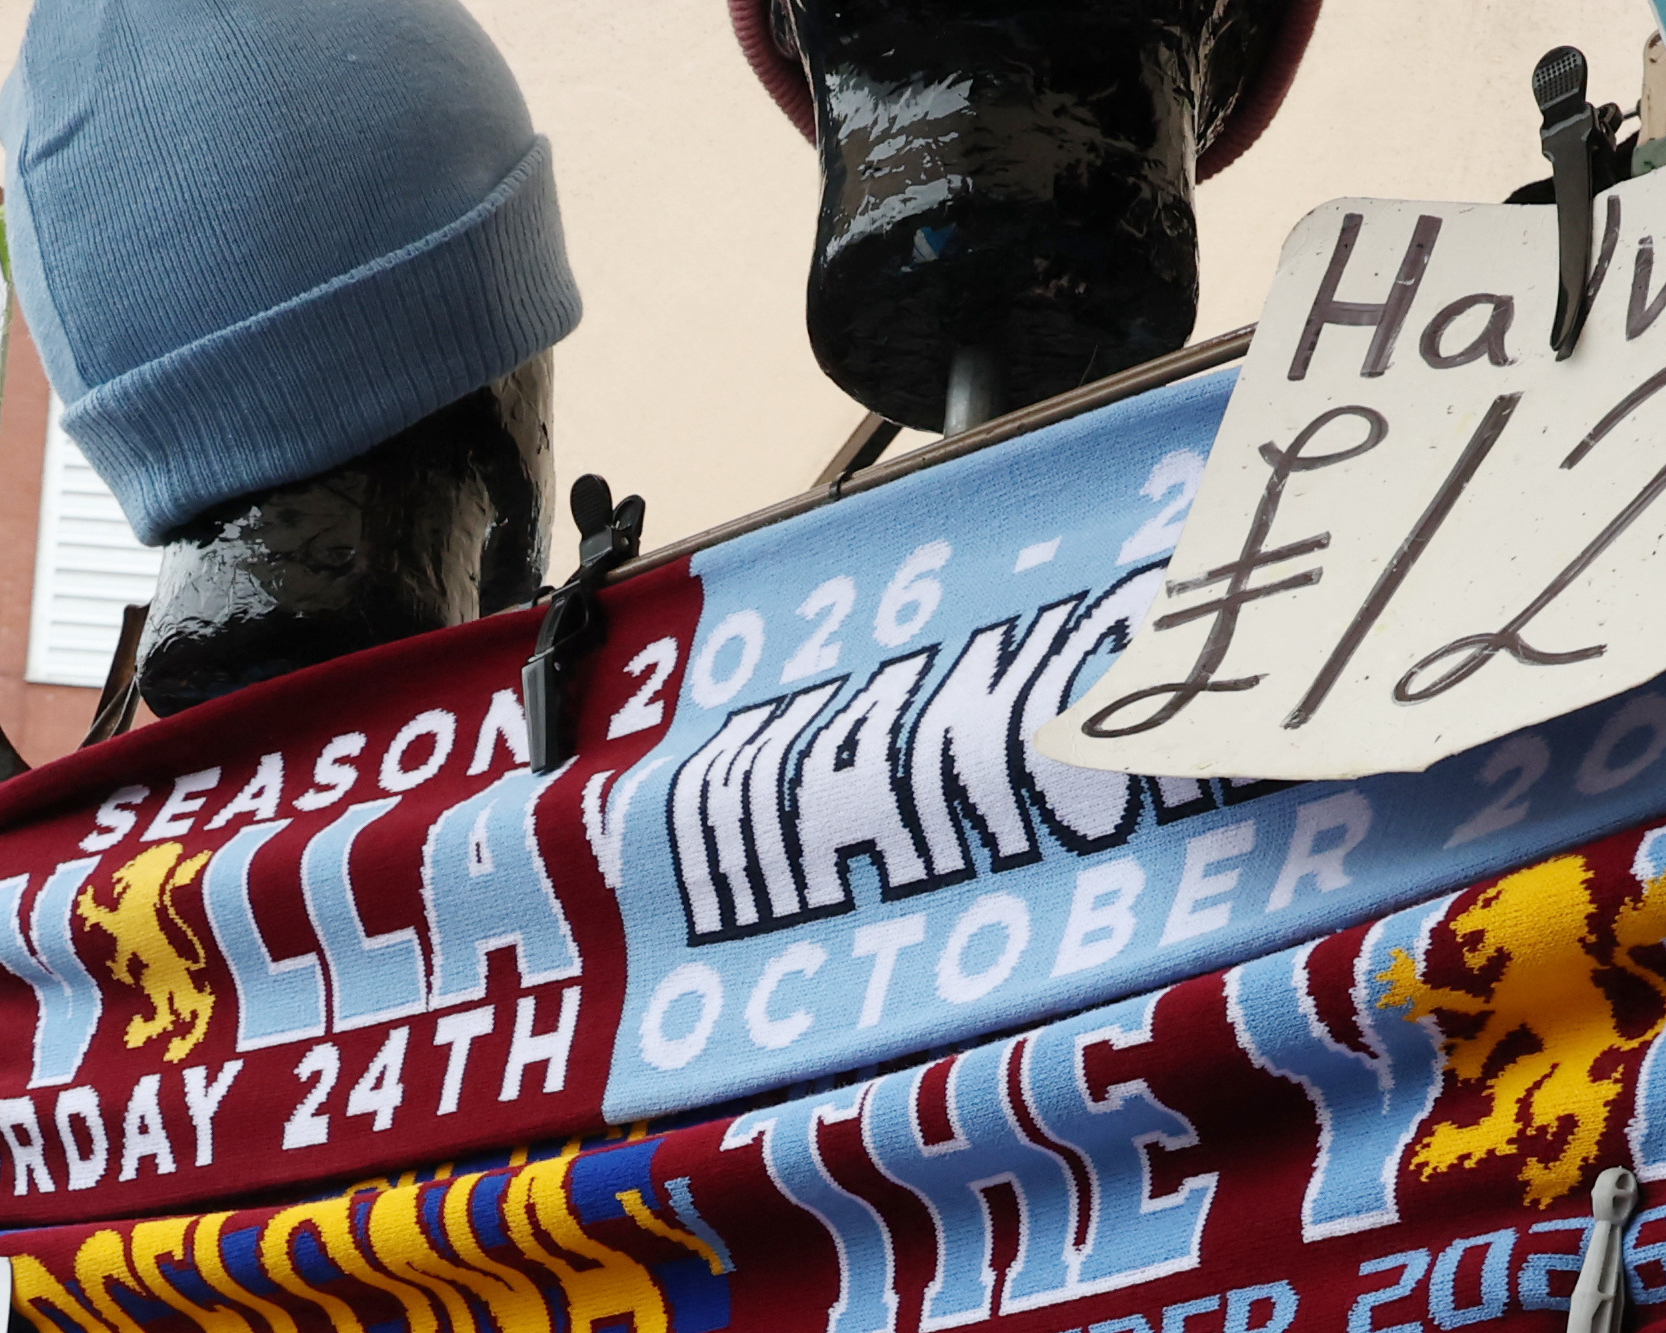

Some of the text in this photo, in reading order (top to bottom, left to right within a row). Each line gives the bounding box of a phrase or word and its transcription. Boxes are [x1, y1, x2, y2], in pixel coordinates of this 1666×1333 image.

[79, 687, 531, 853] SEASON
[607, 538, 953, 740] 2026
[282, 985, 583, 1149] 24TH
[638, 788, 1377, 1072] OCTOBER
